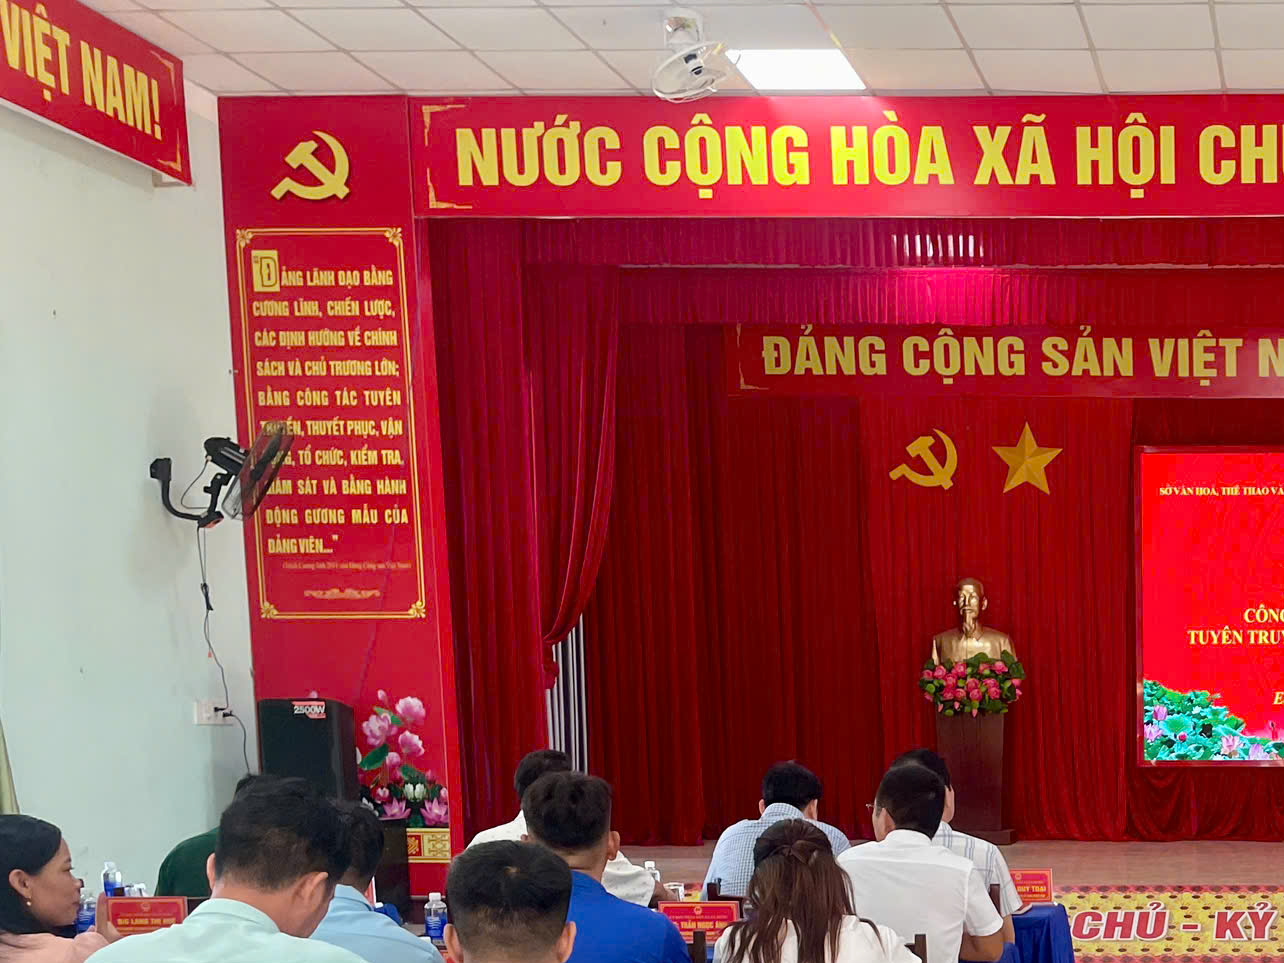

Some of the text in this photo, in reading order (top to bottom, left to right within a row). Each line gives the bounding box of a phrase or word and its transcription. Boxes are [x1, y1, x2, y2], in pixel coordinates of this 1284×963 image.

[0, 3, 162, 141] VIỆT NAM!
[455, 113, 623, 187] NƯỚC
[643, 112, 810, 199] CỘNG
[830, 110, 955, 187] HÒA
[973, 113, 1056, 186] XÃ
[1076, 112, 1176, 199] HỘI
[338, 270, 360, 289] ĐẠO
[363, 265, 393, 286] BẰNG
[254, 328, 276, 346] CÁC
[364, 328, 398, 346] CHÍNH
[256, 358, 285, 376] SÁCH
[288, 358, 302, 376] VÀ
[305, 356, 326, 376] CHỦ
[329, 360, 372, 376] TRƯƠNG
[762, 324, 887, 376] ĐẢNG
[902, 328, 1026, 386] CỘNG
[1040, 325, 1134, 377] SẢN
[1149, 330, 1244, 387] VIỆT
[258, 385, 401, 406] BẰNG CÔNG TÁC TUYÊN
[298, 474, 407, 495] SÁT VÀ BẰNG HÀNH
[1243, 487, 1270, 496] THAO
[1271, 485, 1284, 496] VÀ
[265, 505, 299, 528] ĐỘNG
[305, 507, 345, 524] GƯƠNG
[384, 504, 408, 524] CỦA
[268, 533, 298, 554] ĐẢNG
[1187, 626, 1243, 644] TUYÊN
[294, 704, 326, 714] 2500W
[1072, 902, 1171, 941] CHỦ
[1213, 902, 1278, 941] KỶ
